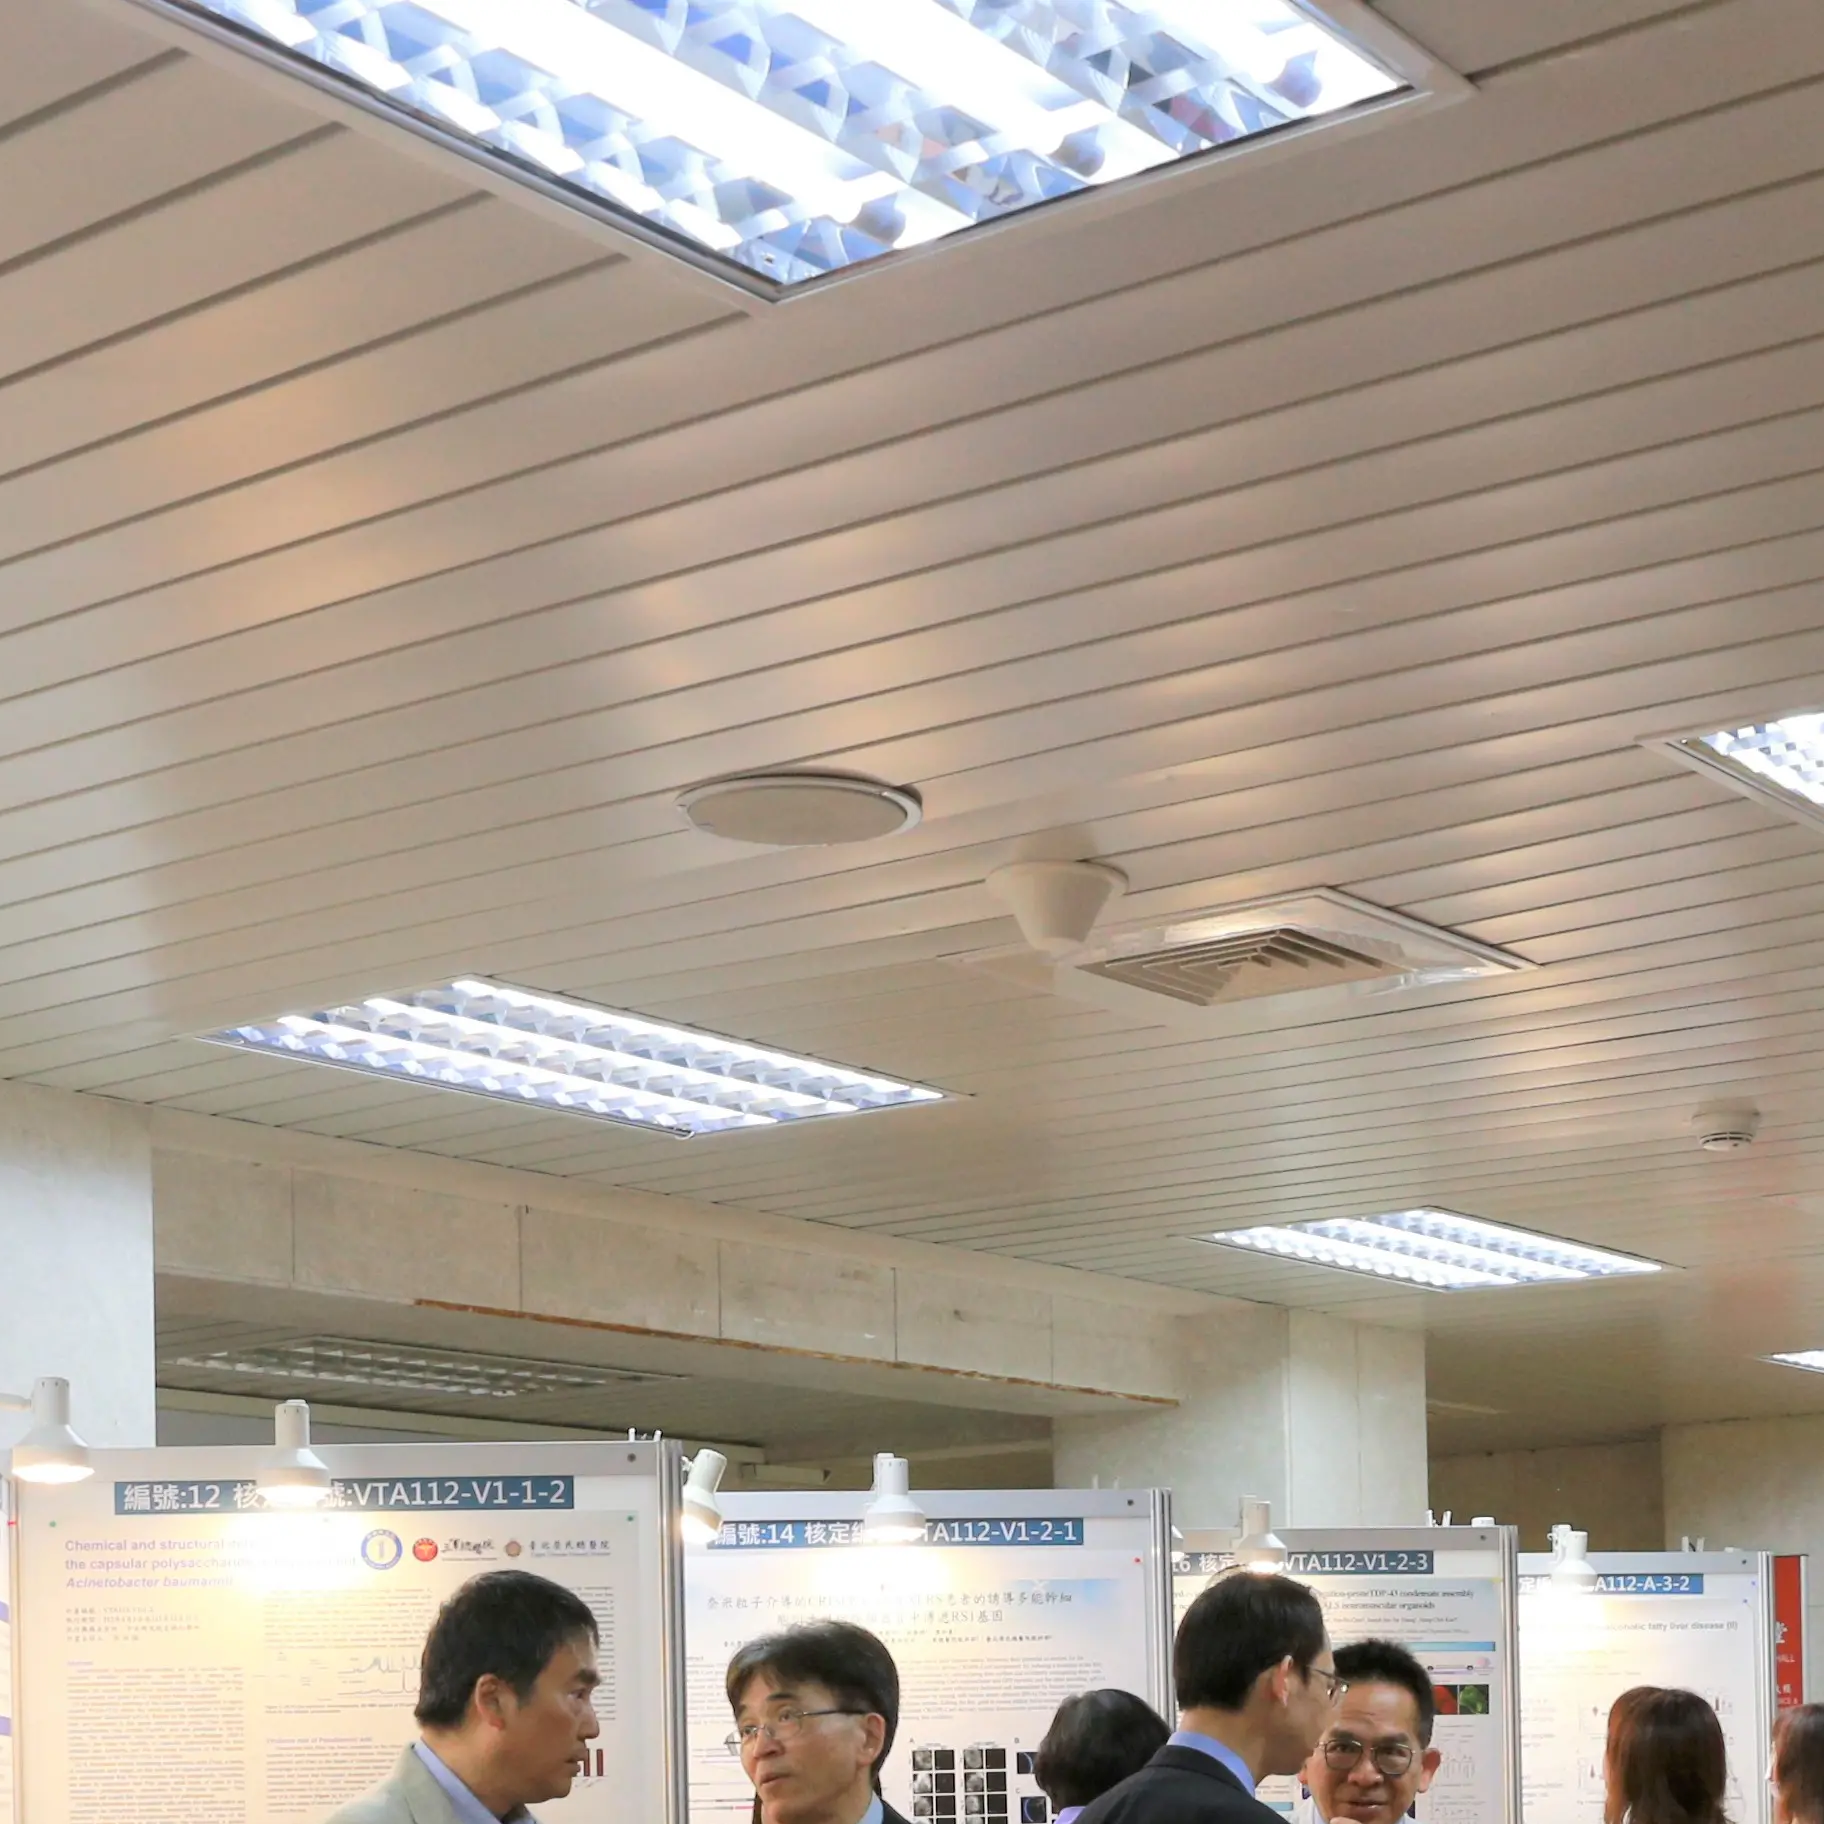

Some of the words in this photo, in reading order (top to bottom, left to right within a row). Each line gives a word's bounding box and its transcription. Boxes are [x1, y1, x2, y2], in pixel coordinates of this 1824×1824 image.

[123, 1483, 221, 1511] 編號:12
[65, 1540, 127, 1552] Chemical
[131, 1539, 156, 1551] and
[159, 1538, 225, 1551] structural
[65, 1558, 86, 1571] the
[90, 1557, 147, 1572] capsular
[66, 1576, 160, 1589] Acinetobacter
[1399, 1600, 1435, 1611] organoids
[1691, 1620, 1724, 1631] disease
